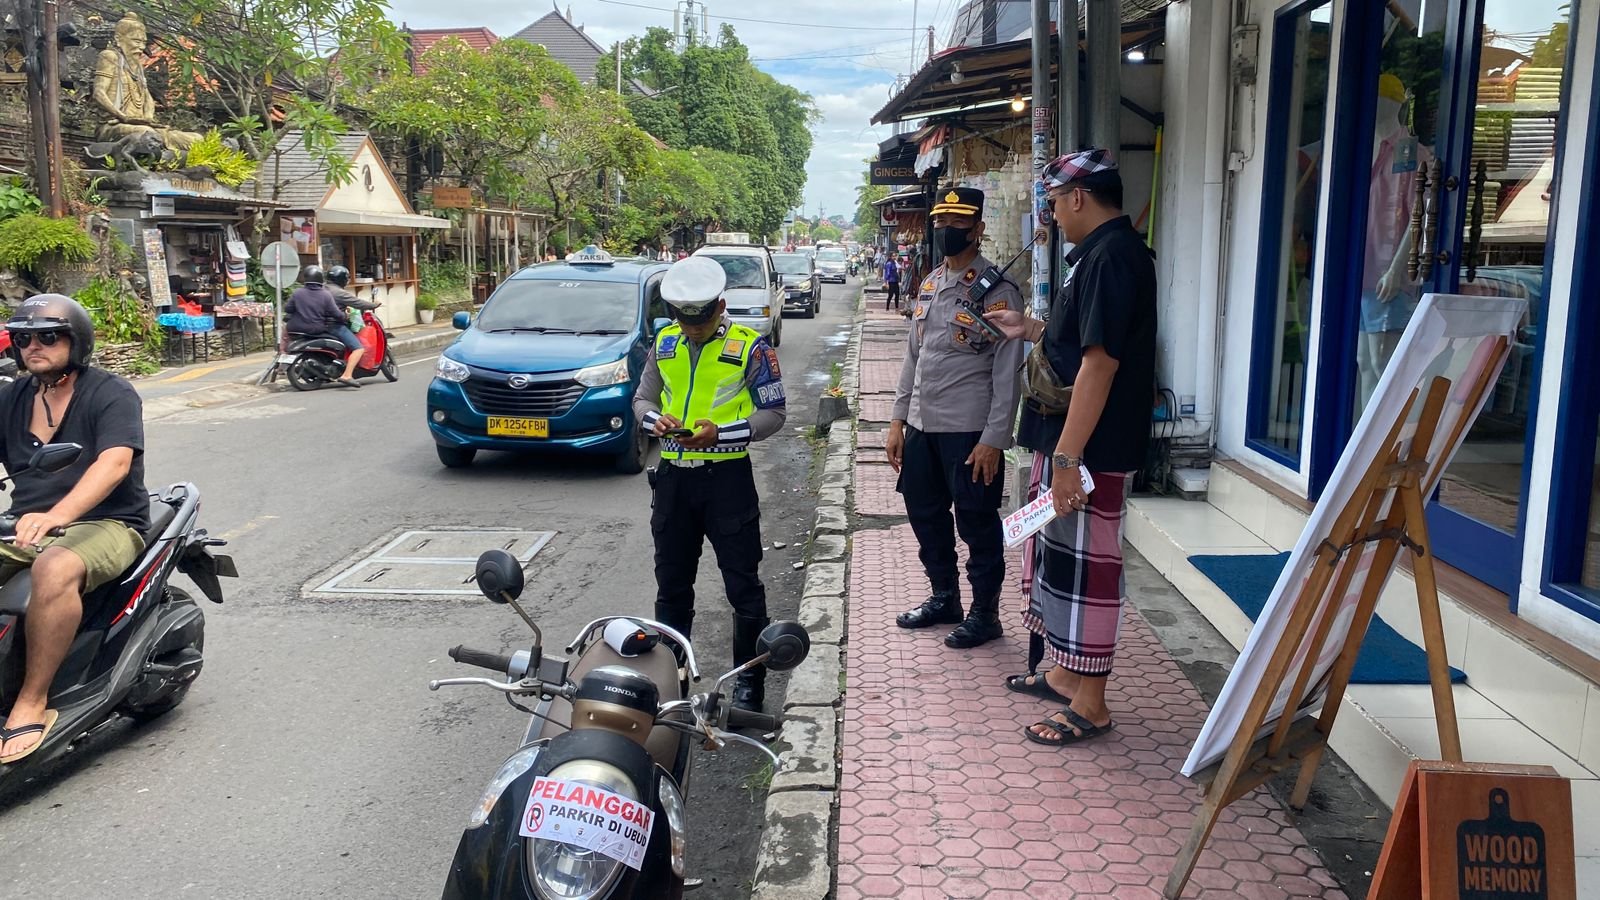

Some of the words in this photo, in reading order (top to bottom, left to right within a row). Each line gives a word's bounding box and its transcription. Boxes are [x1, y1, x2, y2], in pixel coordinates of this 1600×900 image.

[489, 418, 502, 429] DK
[504, 419, 527, 430] 1254
[603, 685, 638, 698] HONDA
[531, 780, 650, 832] PELANGGAR
[549, 804, 605, 828] PARKIR
[607, 820, 622, 834] DI
[624, 826, 647, 847] UBUD
[1464, 834, 1538, 864] WOOD
[1464, 866, 1541, 893] MEMORY
